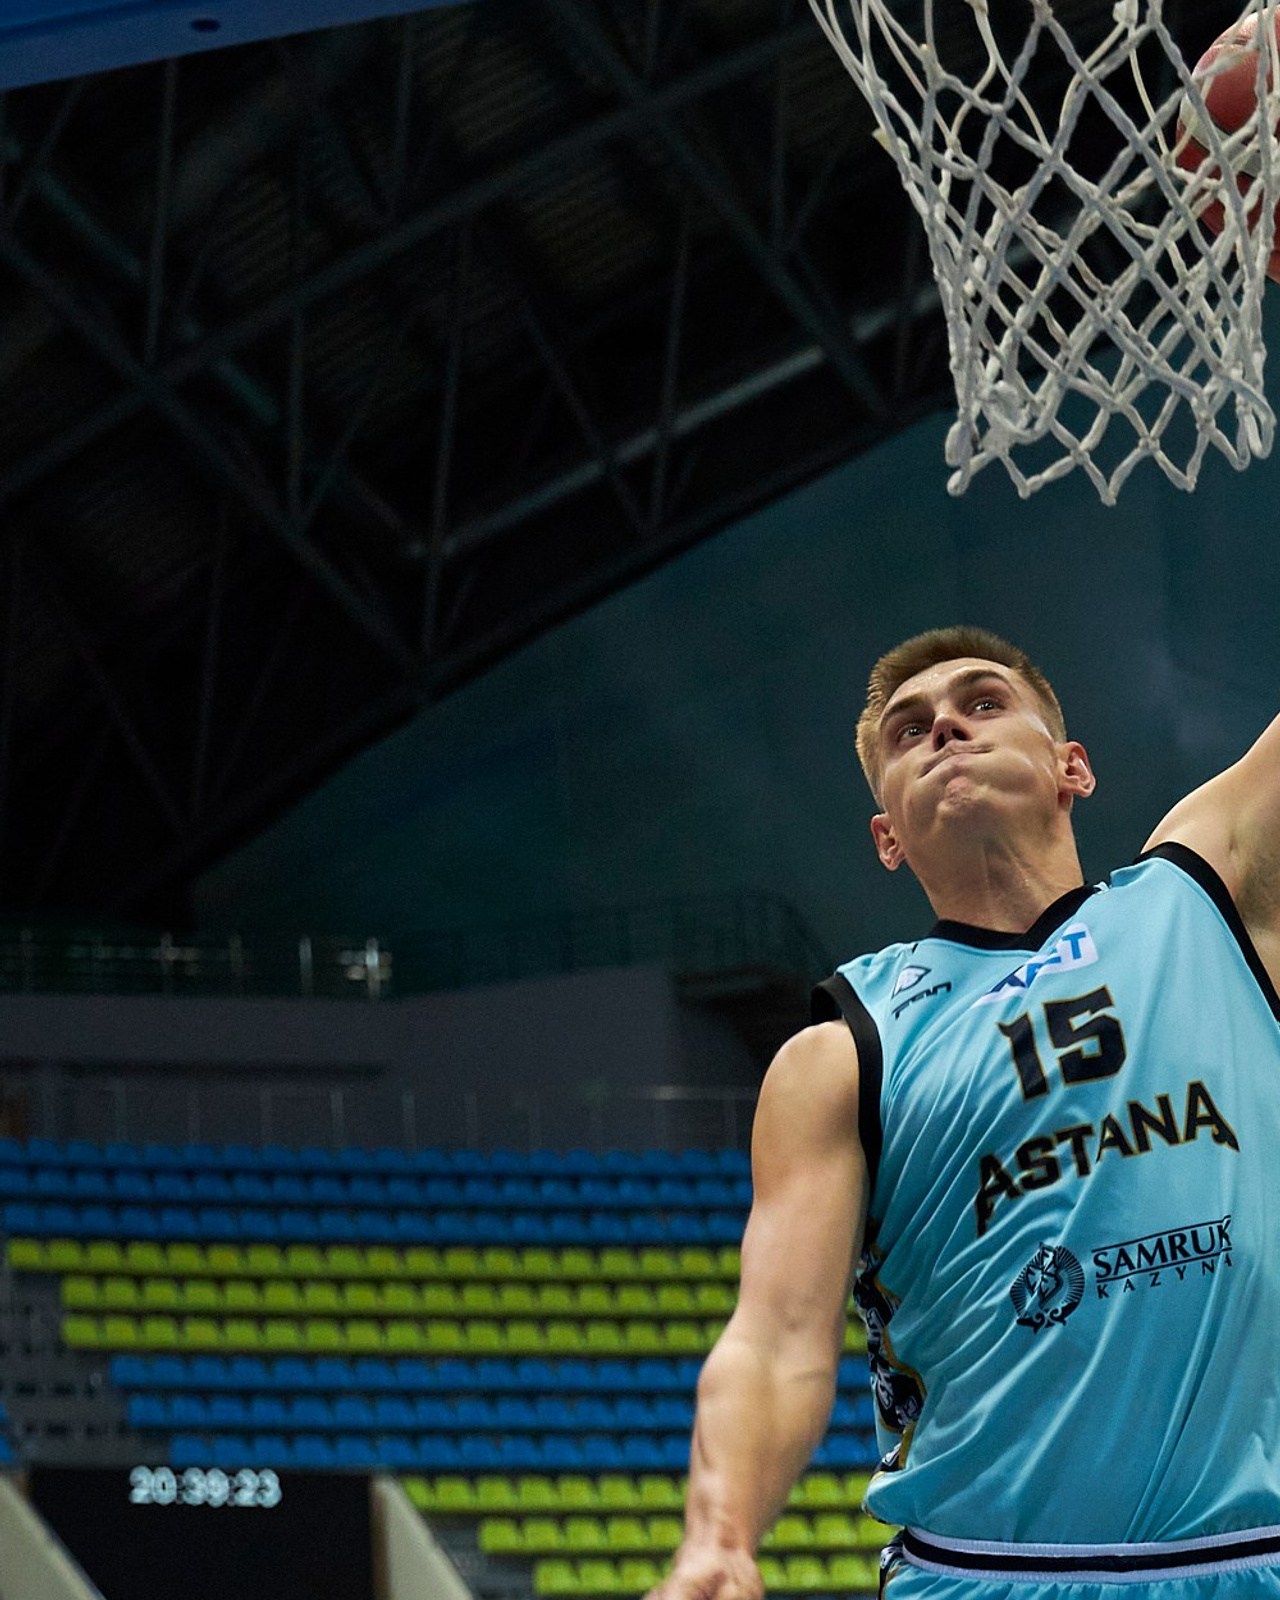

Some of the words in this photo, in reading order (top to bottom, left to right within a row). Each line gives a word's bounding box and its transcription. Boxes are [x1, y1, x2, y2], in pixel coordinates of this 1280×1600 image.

[996, 984, 1128, 1101] 15
[974, 1080, 1240, 1238] ASTANA
[1093, 1219, 1232, 1278] SAMRUK
[1096, 1252, 1233, 1299] KAZYNA
